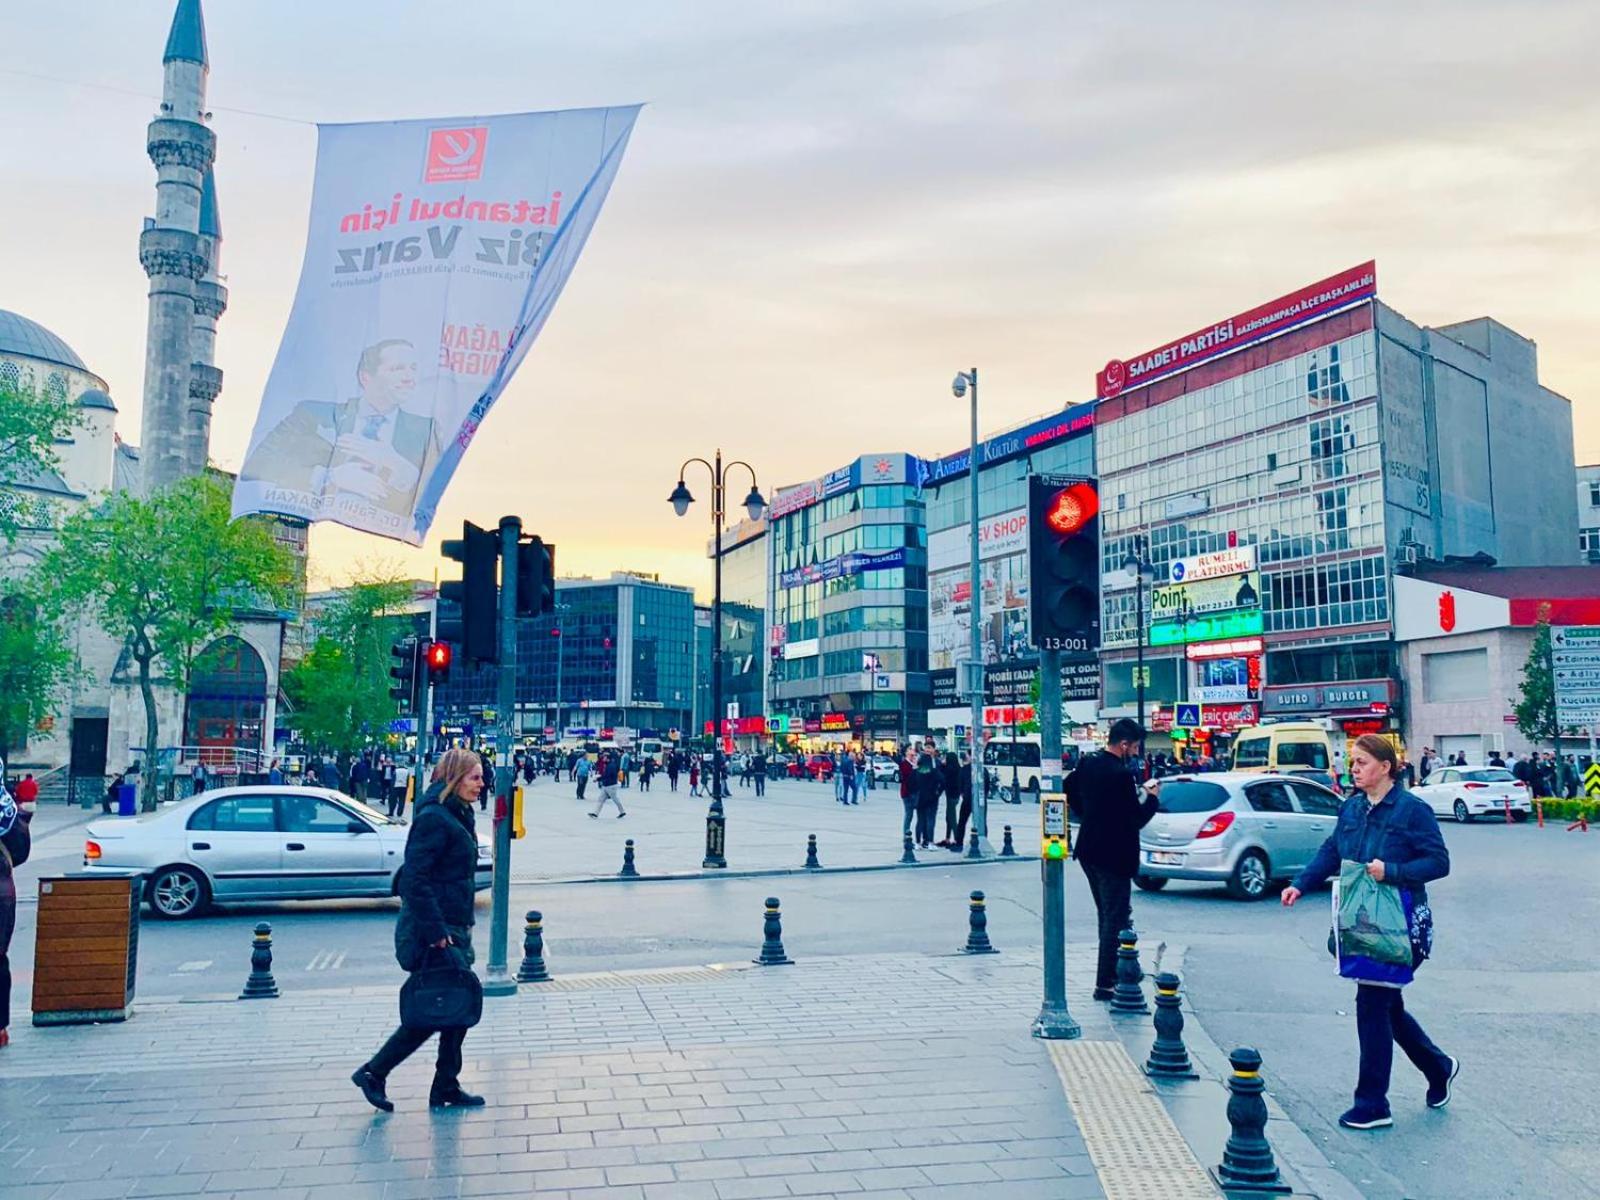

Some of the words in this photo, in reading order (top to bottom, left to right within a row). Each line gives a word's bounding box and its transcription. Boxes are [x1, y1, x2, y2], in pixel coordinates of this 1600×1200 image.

[1129, 346, 1179, 378] SAADET
[1180, 319, 1234, 358] PARTİSİ
[935, 458, 973, 480] AMERİKA
[983, 437, 1020, 461] KÜLTÜR
[993, 515, 1027, 539] SHOP
[1152, 586, 1187, 610] Point
[1045, 637, 1088, 651] 13-001
[1328, 690, 1370, 702] BURGER
[1202, 707, 1222, 724] ERİÇ
